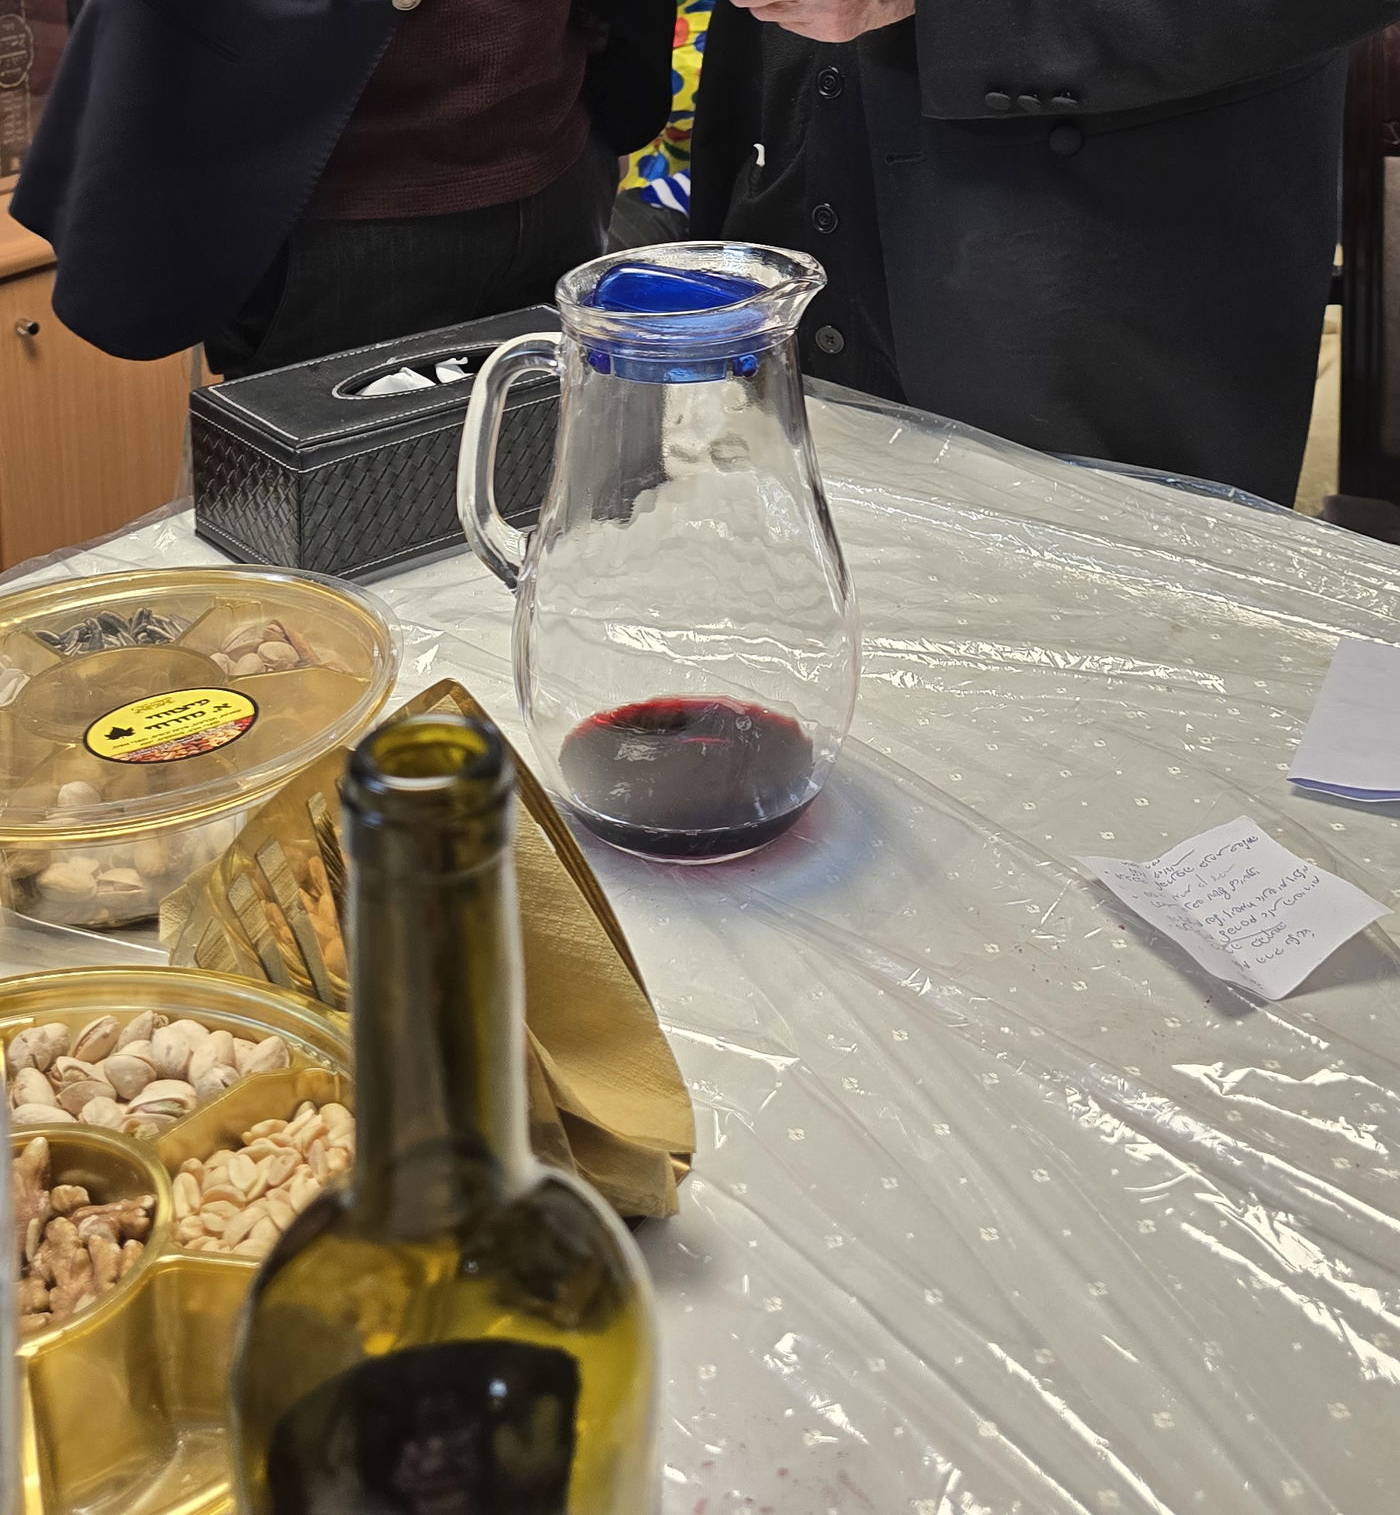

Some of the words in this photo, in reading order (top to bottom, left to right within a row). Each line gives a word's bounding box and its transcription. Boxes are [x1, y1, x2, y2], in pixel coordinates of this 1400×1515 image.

[145, 698, 211, 720] פיצוחי
[212, 703, 233, 714] א.
[144, 711, 207, 731] מזרחי
[1261, 897, 1288, 917] את
